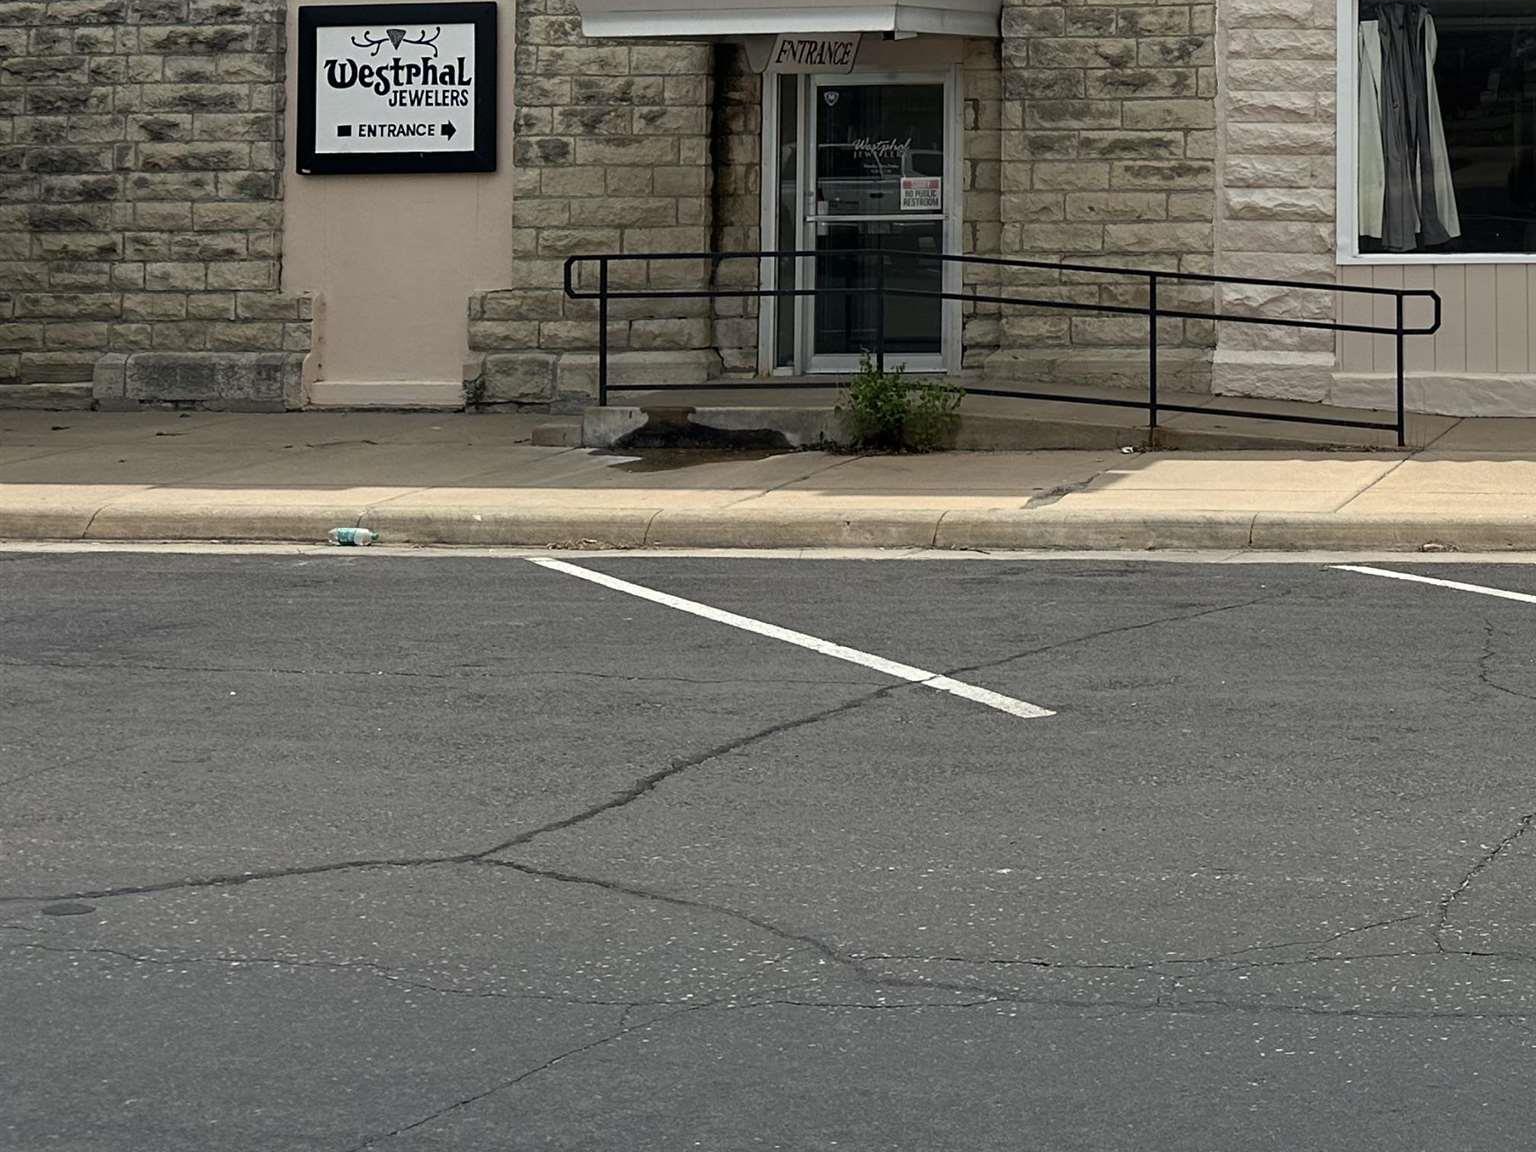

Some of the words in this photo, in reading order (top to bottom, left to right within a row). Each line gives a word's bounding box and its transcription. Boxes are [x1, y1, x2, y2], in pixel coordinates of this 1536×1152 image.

[775, 39, 853, 65] ENTRANCE
[323, 56, 472, 96] Westphal
[388, 89, 469, 108] JEWELERS
[358, 123, 436, 138] ENTRANCE
[903, 198, 939, 206] RESTROOM
